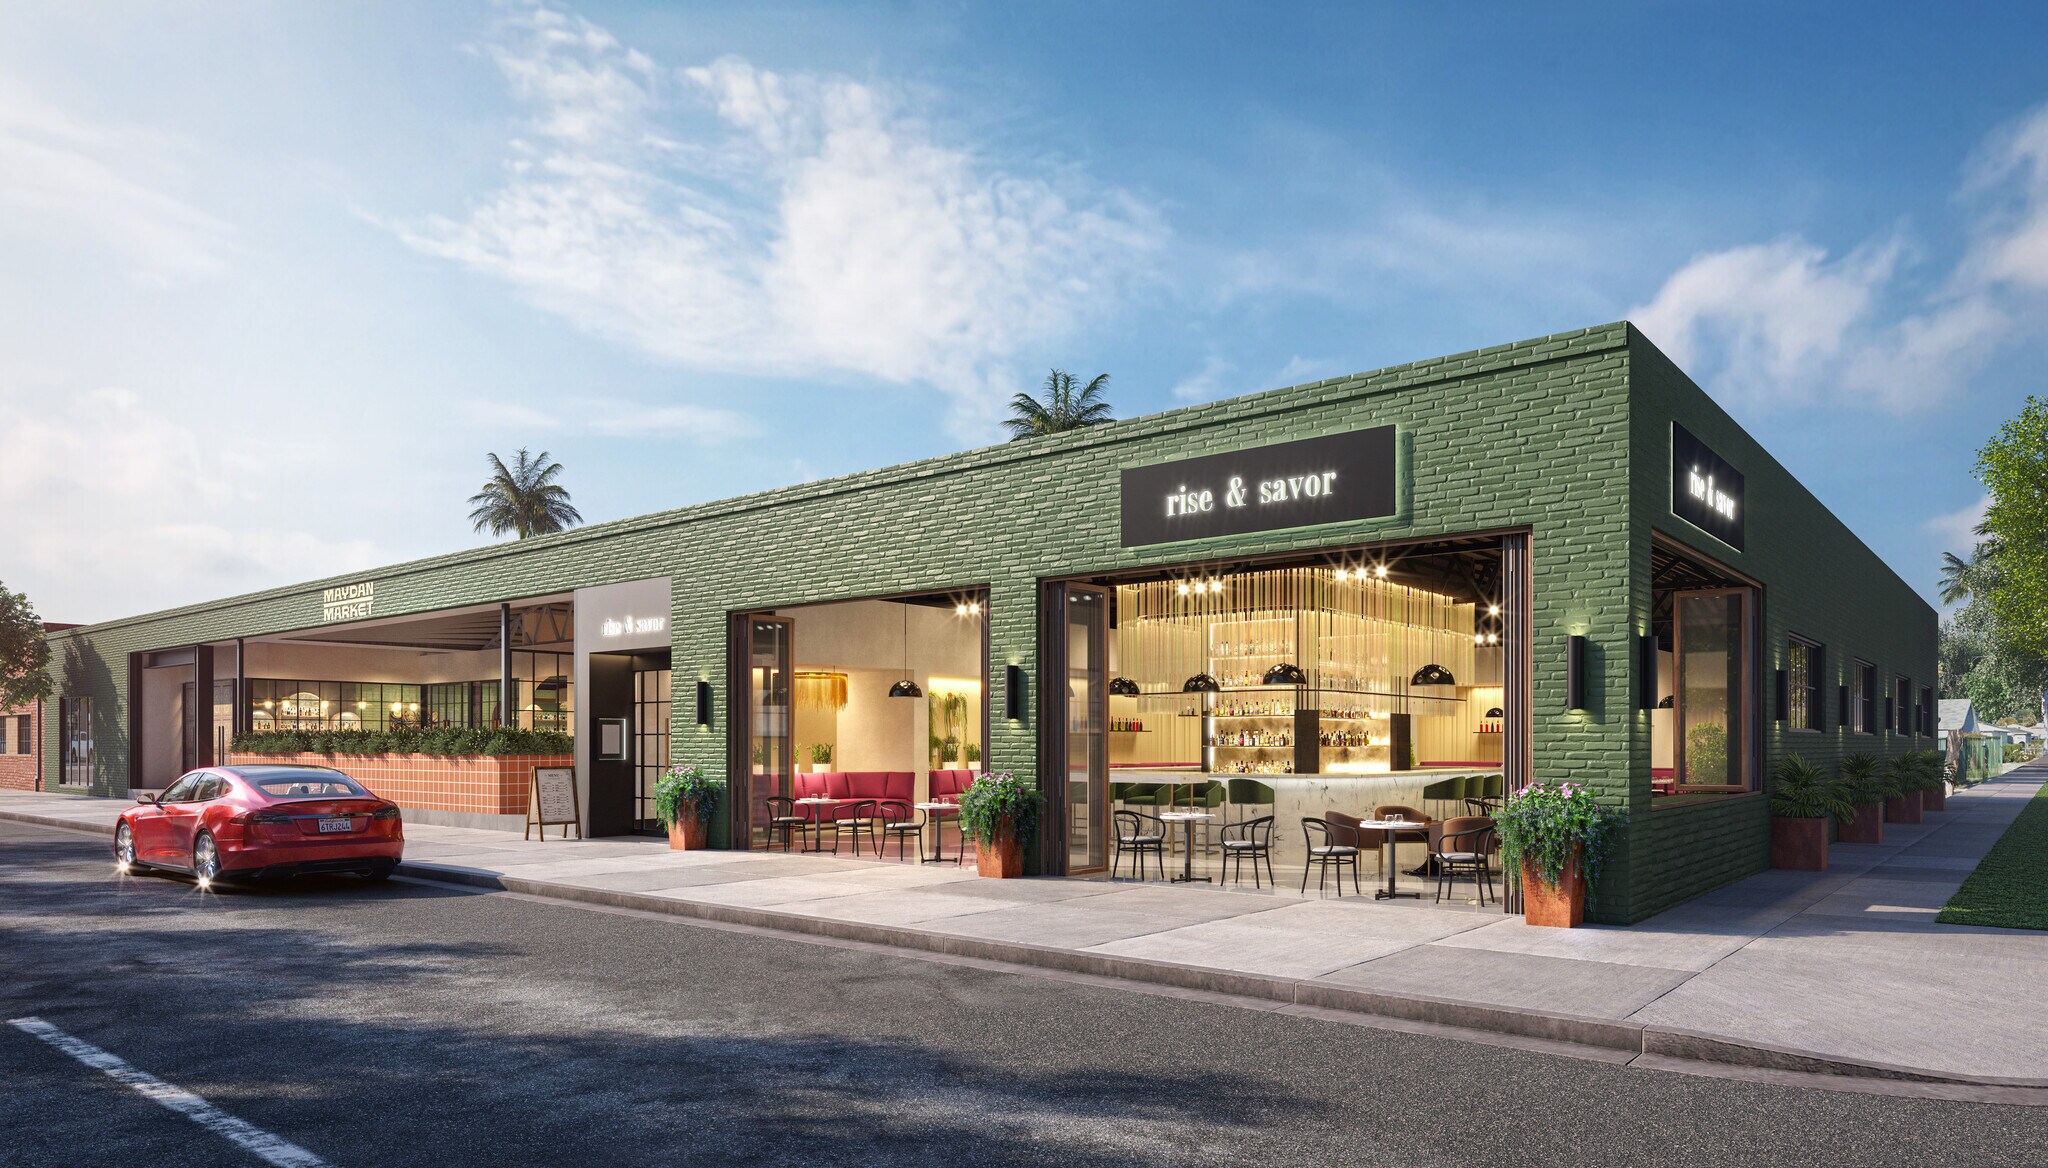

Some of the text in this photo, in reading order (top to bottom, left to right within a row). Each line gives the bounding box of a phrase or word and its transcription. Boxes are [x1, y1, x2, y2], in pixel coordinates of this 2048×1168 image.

[1167, 472, 1337, 517] rise & savor
[1690, 465, 1734, 520] rise & savor
[323, 581, 374, 602] MAYDAN
[323, 601, 374, 621] MARKET
[602, 618, 621, 635] rise
[635, 617, 664, 632] savor
[320, 822, 350, 831] 6TRJ244
